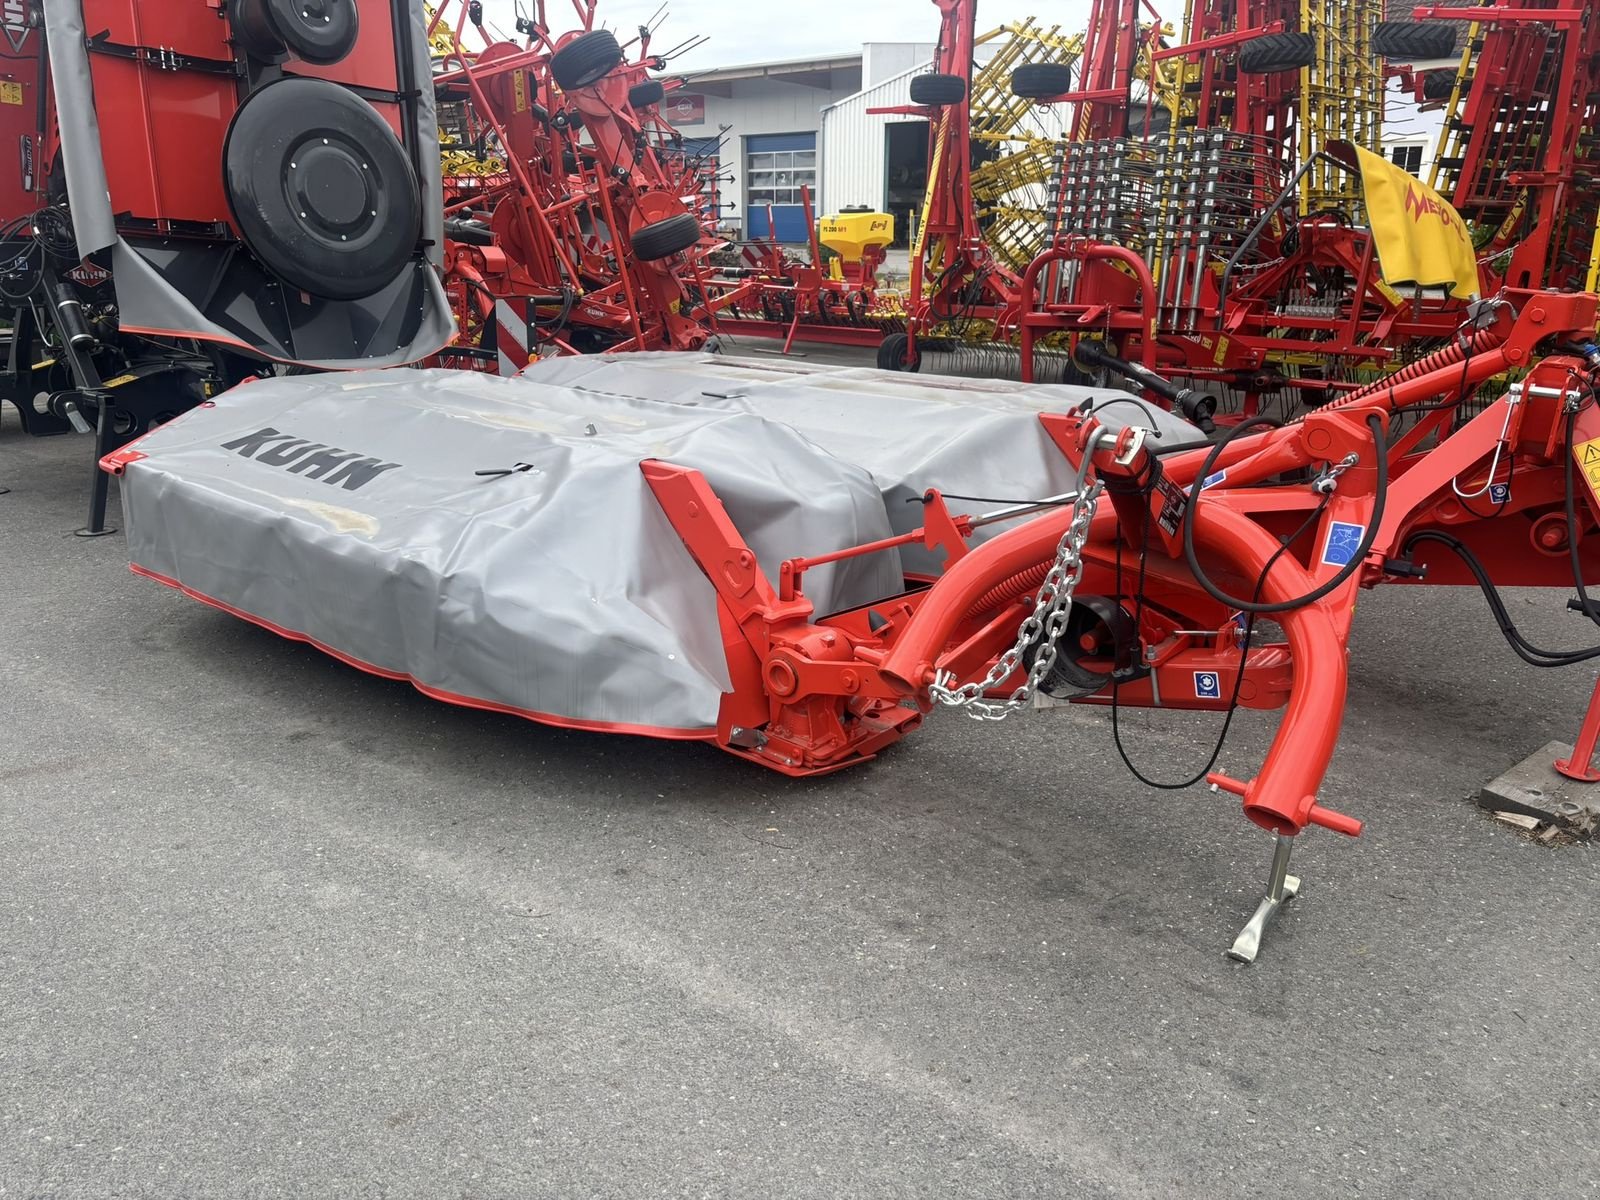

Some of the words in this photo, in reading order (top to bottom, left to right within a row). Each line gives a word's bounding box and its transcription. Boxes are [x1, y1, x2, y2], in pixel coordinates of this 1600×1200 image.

[780, 173, 786, 184] 2
[587, 307, 604, 317] KUHN
[219, 427, 403, 491] KUHN
